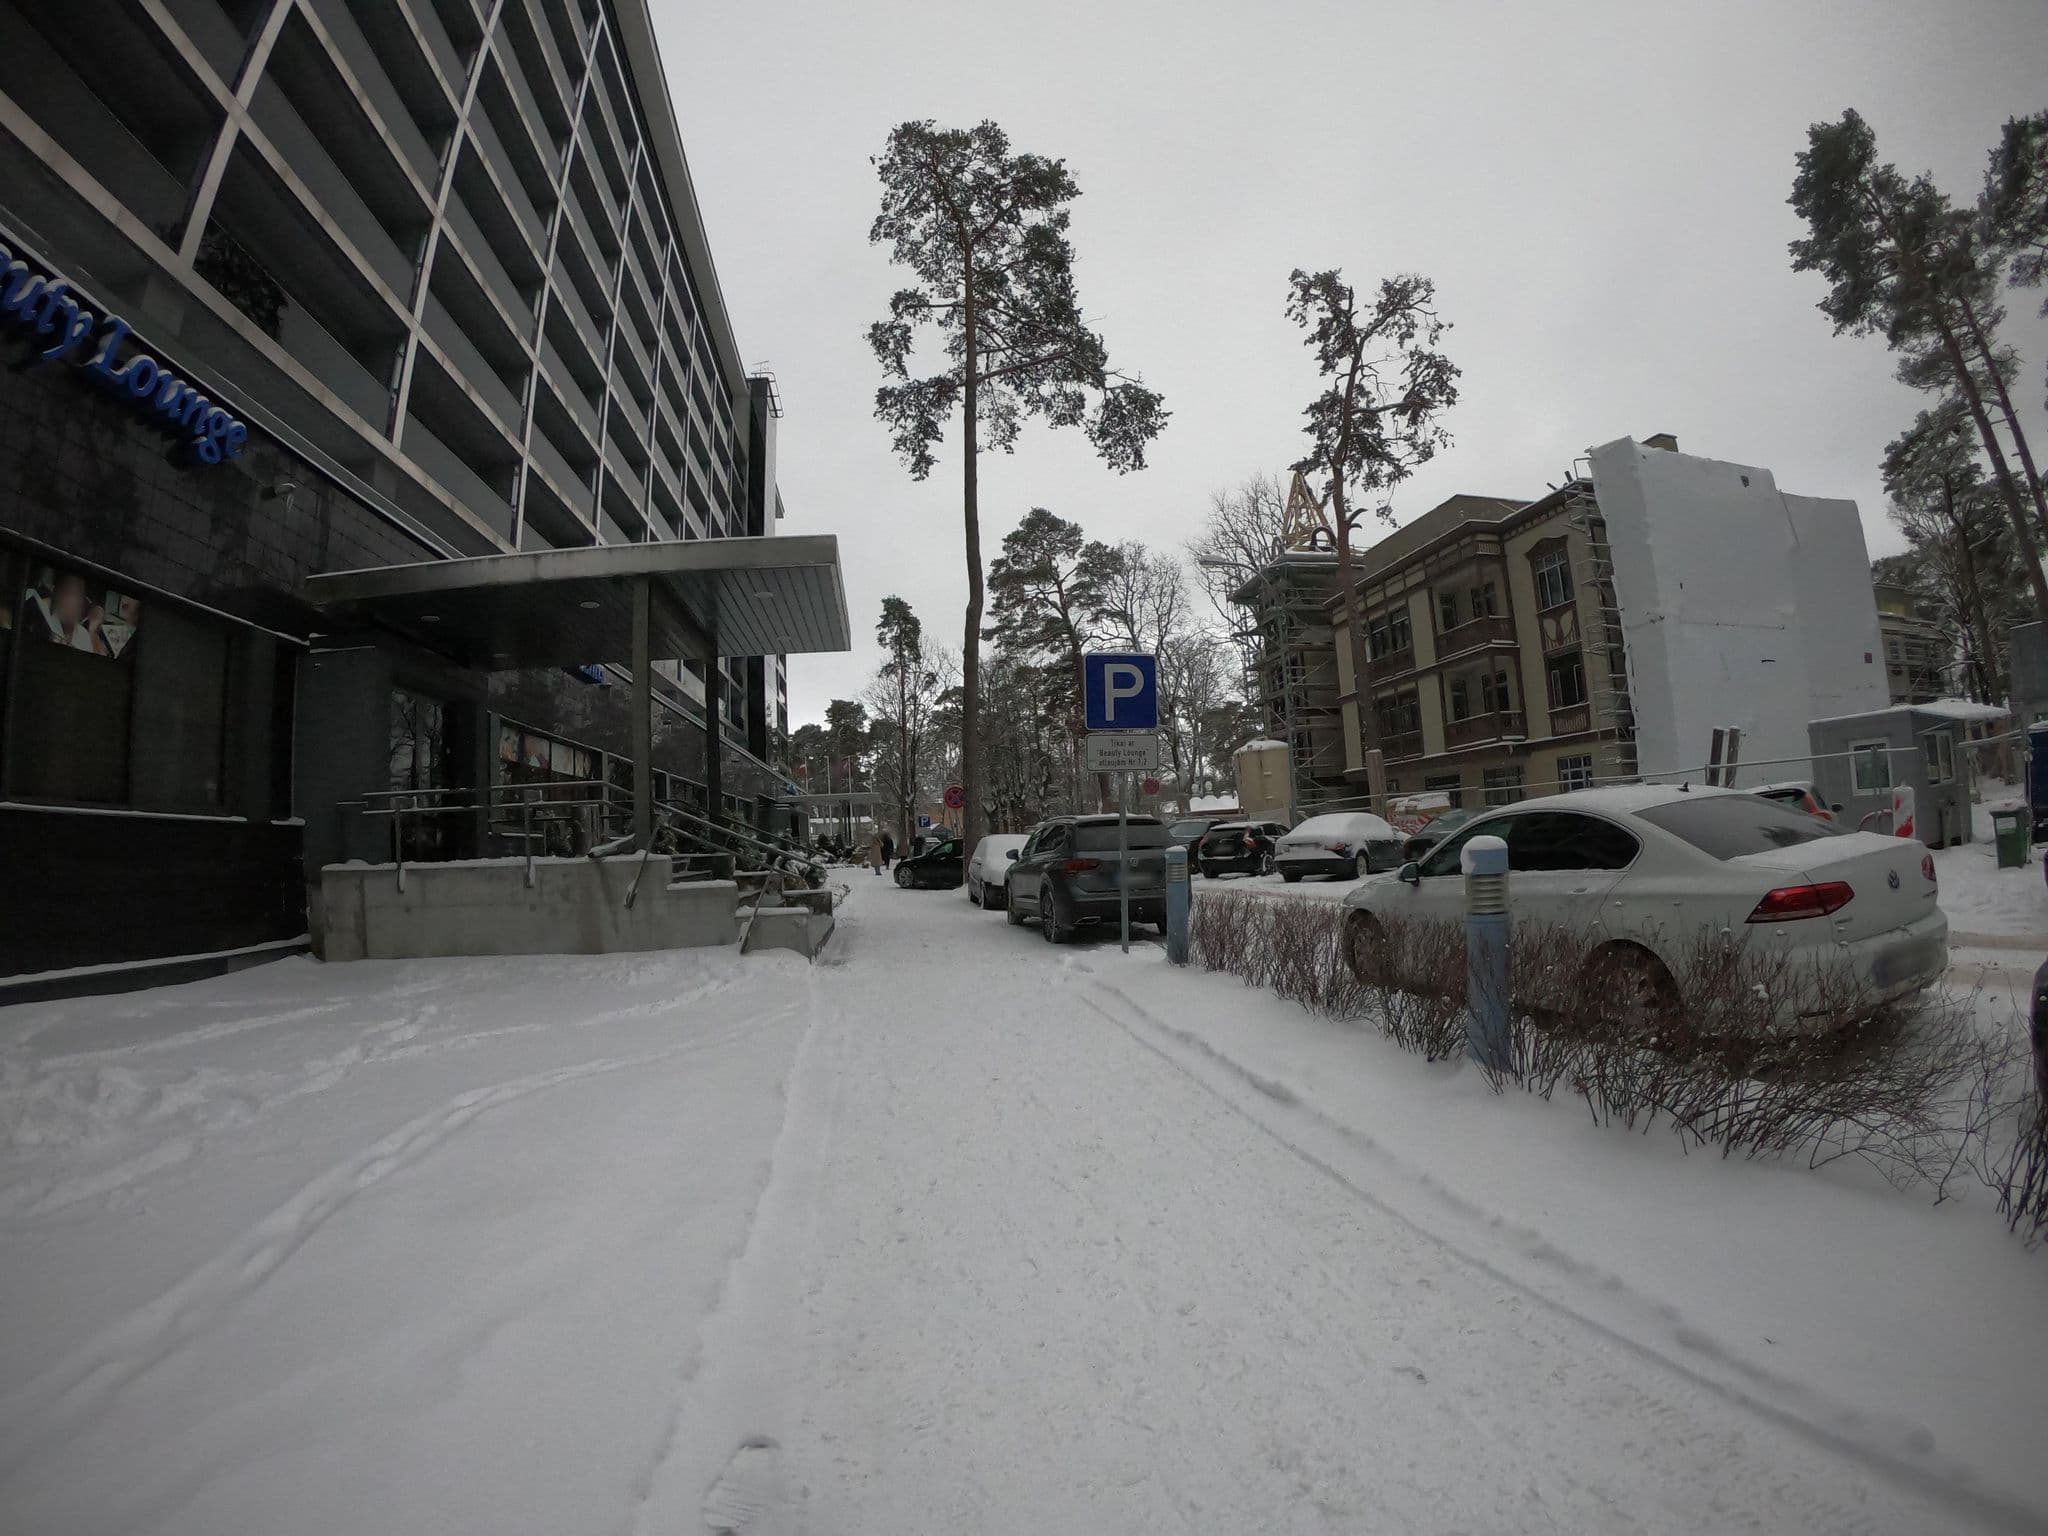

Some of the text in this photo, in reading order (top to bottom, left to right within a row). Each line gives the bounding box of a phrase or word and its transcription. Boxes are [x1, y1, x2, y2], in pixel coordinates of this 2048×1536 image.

[80, 315, 248, 465] Lounge
[1104, 663, 1145, 721] P
[921, 816, 929, 826] P
